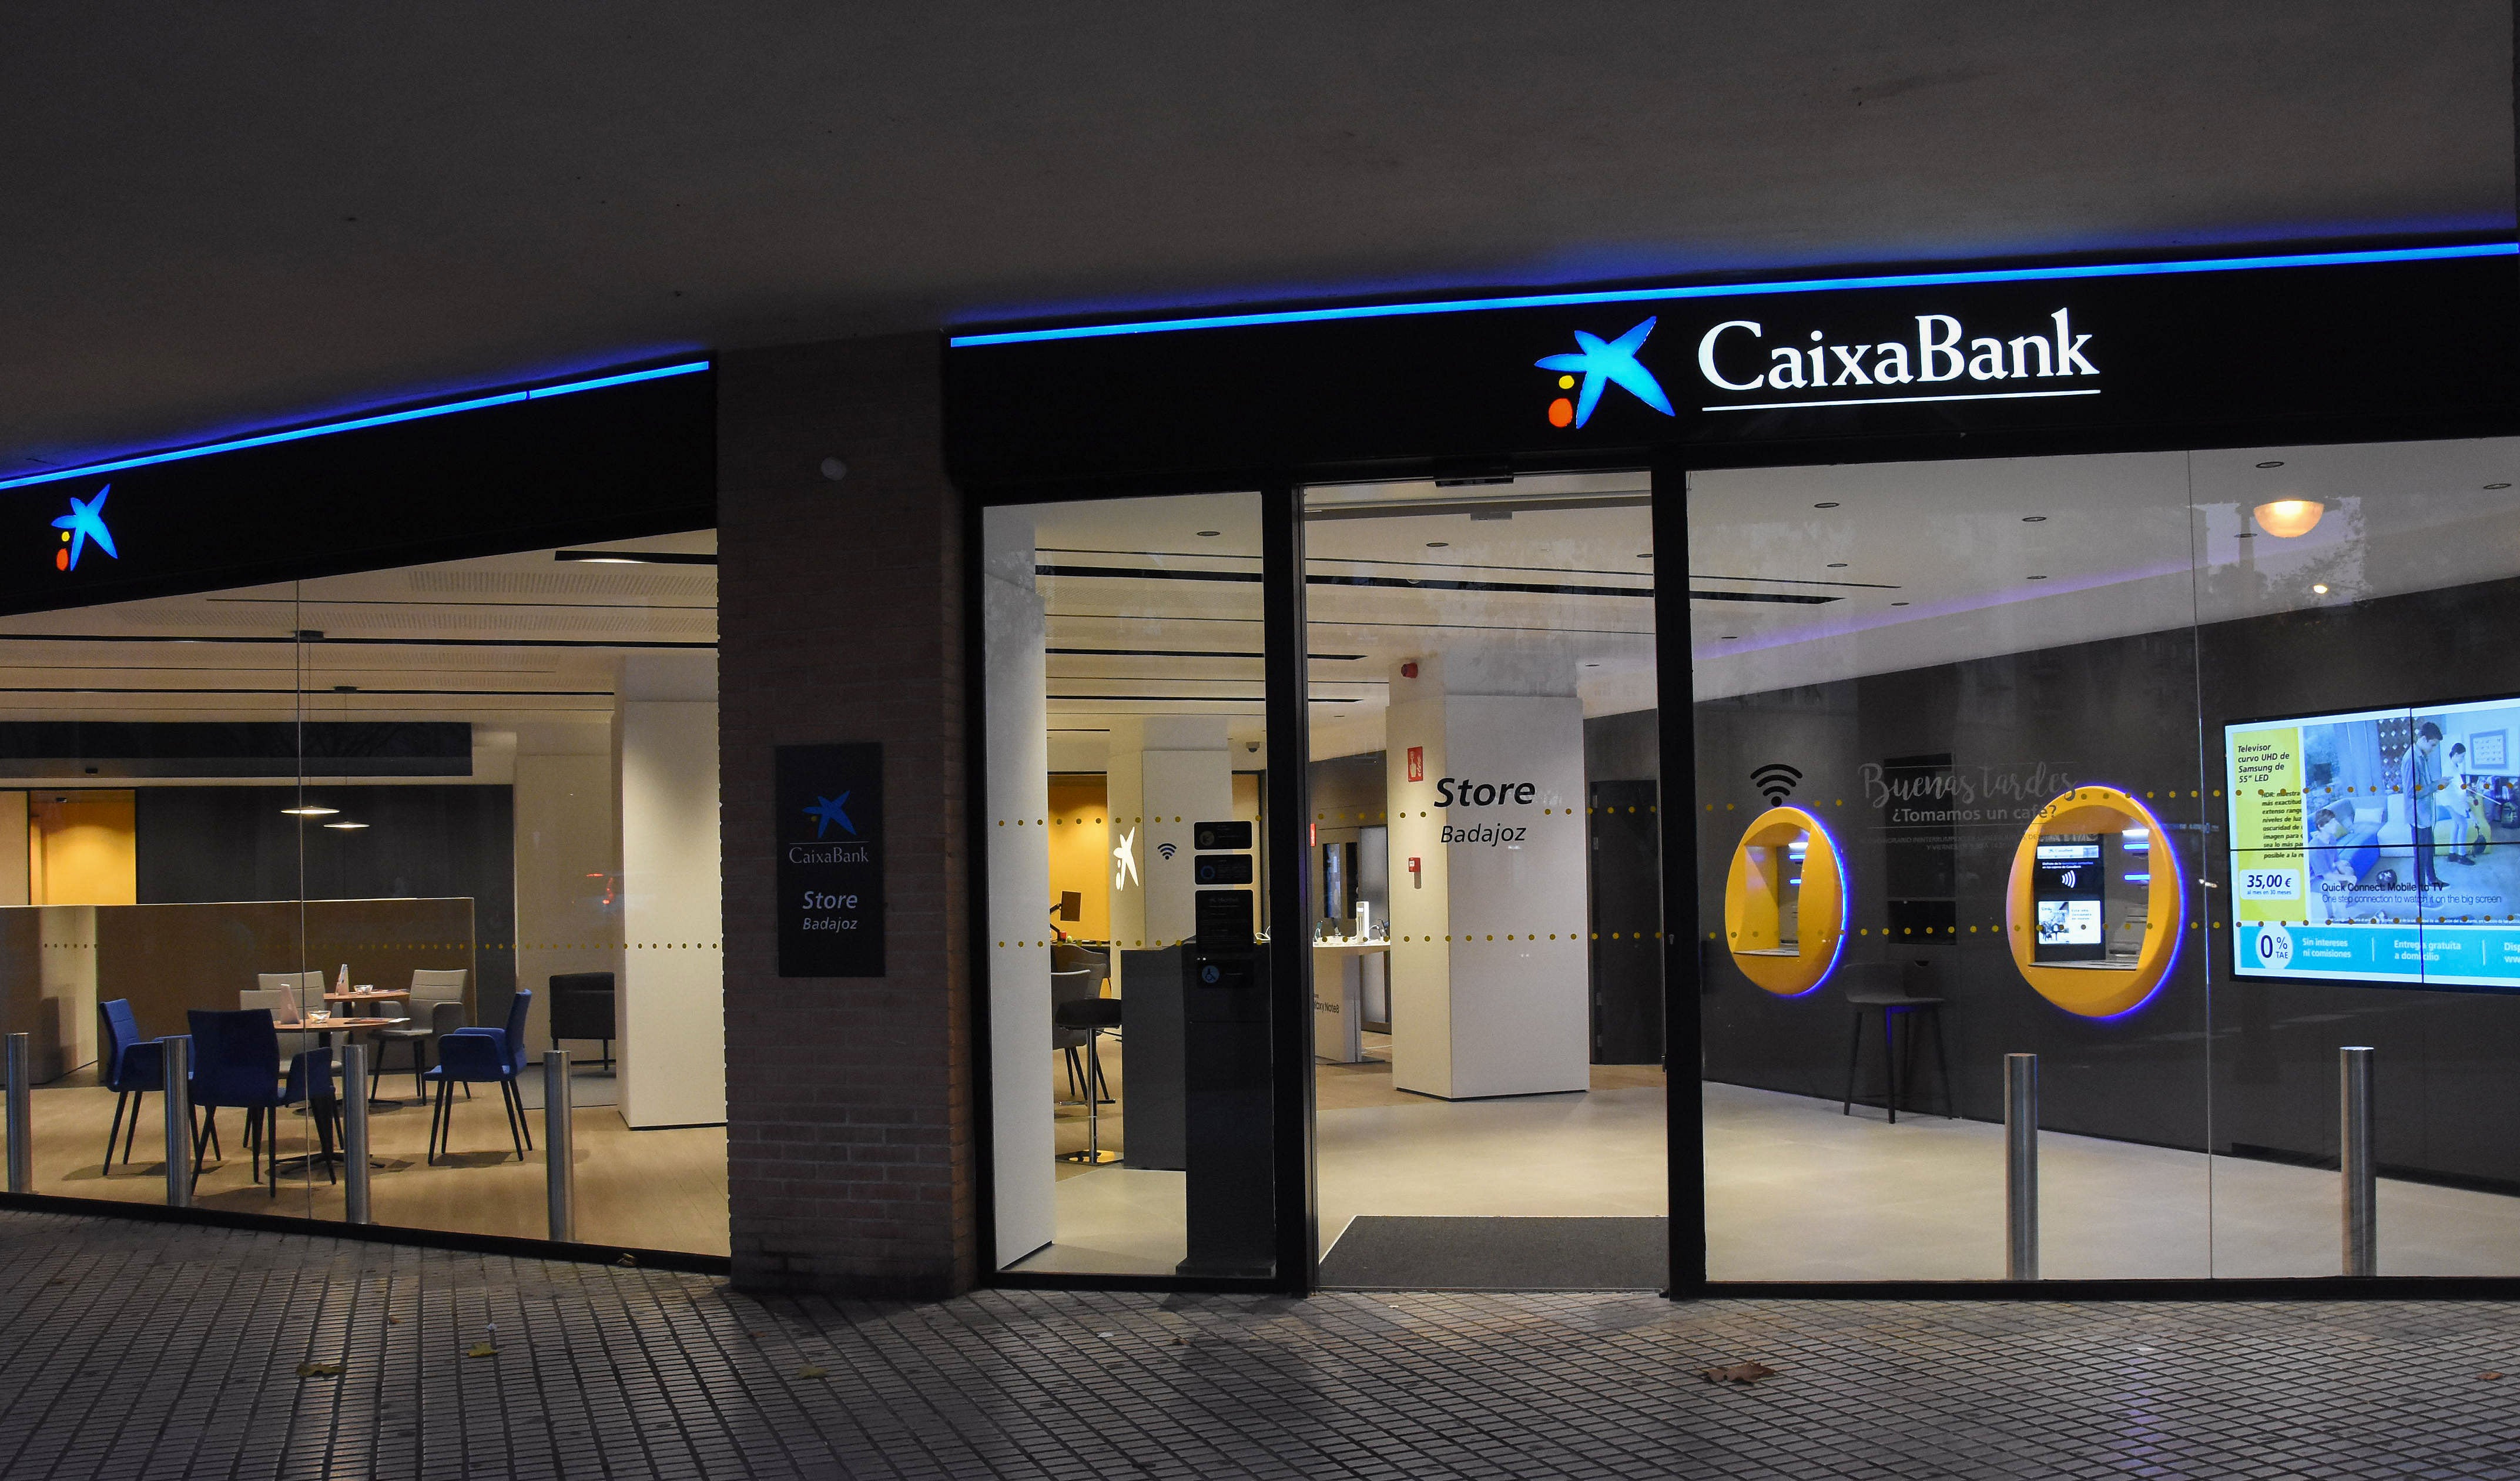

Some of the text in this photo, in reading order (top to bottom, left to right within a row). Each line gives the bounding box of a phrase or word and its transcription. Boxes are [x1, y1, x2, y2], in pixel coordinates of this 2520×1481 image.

[1698, 307, 2100, 390] CaixaBank
[2238, 743, 2271, 753] Televisor
[2261, 753, 2277, 761] UHD
[2238, 765, 2273, 773] Samsung
[2254, 774, 2268, 782] LED
[1433, 778, 1536, 807] Store
[1858, 763, 1976, 809] Buenas
[1892, 808, 1981, 823] ¿Tomamos
[1987, 809, 2006, 820] un
[1440, 823, 1526, 847] Badajoz
[789, 846, 869, 865] CaixaBank
[2247, 874, 2291, 889] 35,00 €
[2322, 883, 2345, 892] Quick
[2388, 882, 2417, 891] Mobile
[2421, 883, 2429, 891] to
[2432, 882, 2443, 891] TV
[802, 890, 857, 910] Store
[2322, 894, 2337, 903] One
[2338, 895, 2353, 905] step
[2354, 894, 2393, 903] connection
[2448, 894, 2460, 903] the
[2461, 895, 2474, 905] big
[803, 917, 857, 933] Badajoz
[2261, 935, 2287, 958] 0 %
[2303, 937, 2348, 947] Sin intereses
[2311, 949, 2351, 958] comisiones
[2401, 951, 2439, 961] domicilio
